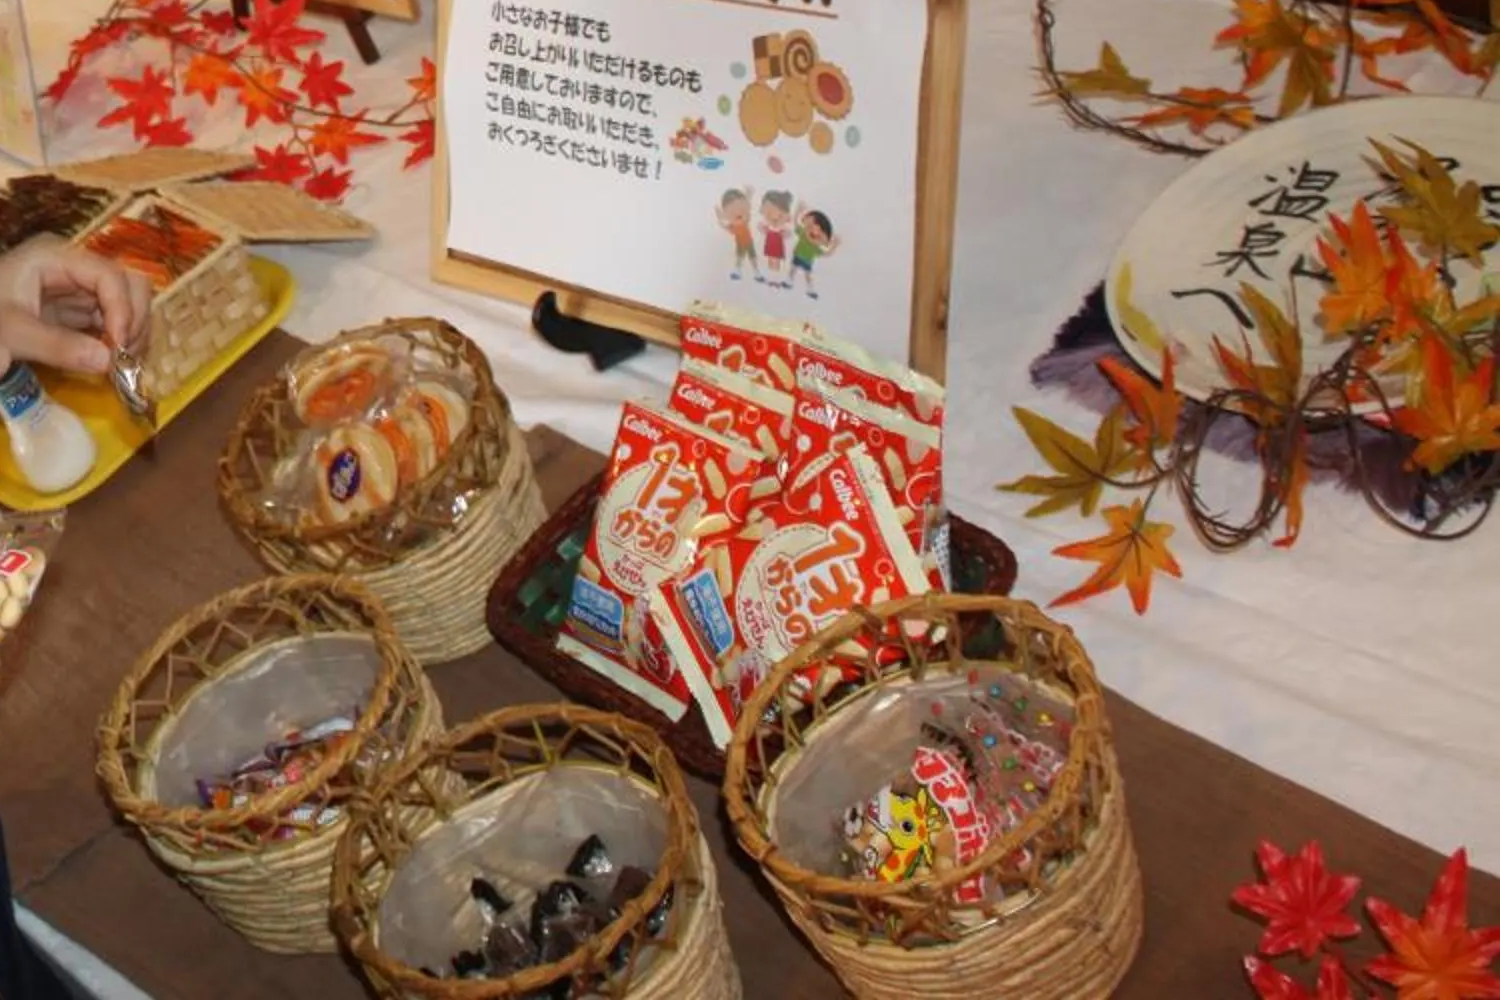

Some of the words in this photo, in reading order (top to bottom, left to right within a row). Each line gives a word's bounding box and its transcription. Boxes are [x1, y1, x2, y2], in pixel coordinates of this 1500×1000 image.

[492, 0, 611, 43] 小さなお子様でも
[489, 31, 703, 93] お召し上がりいただけるものも
